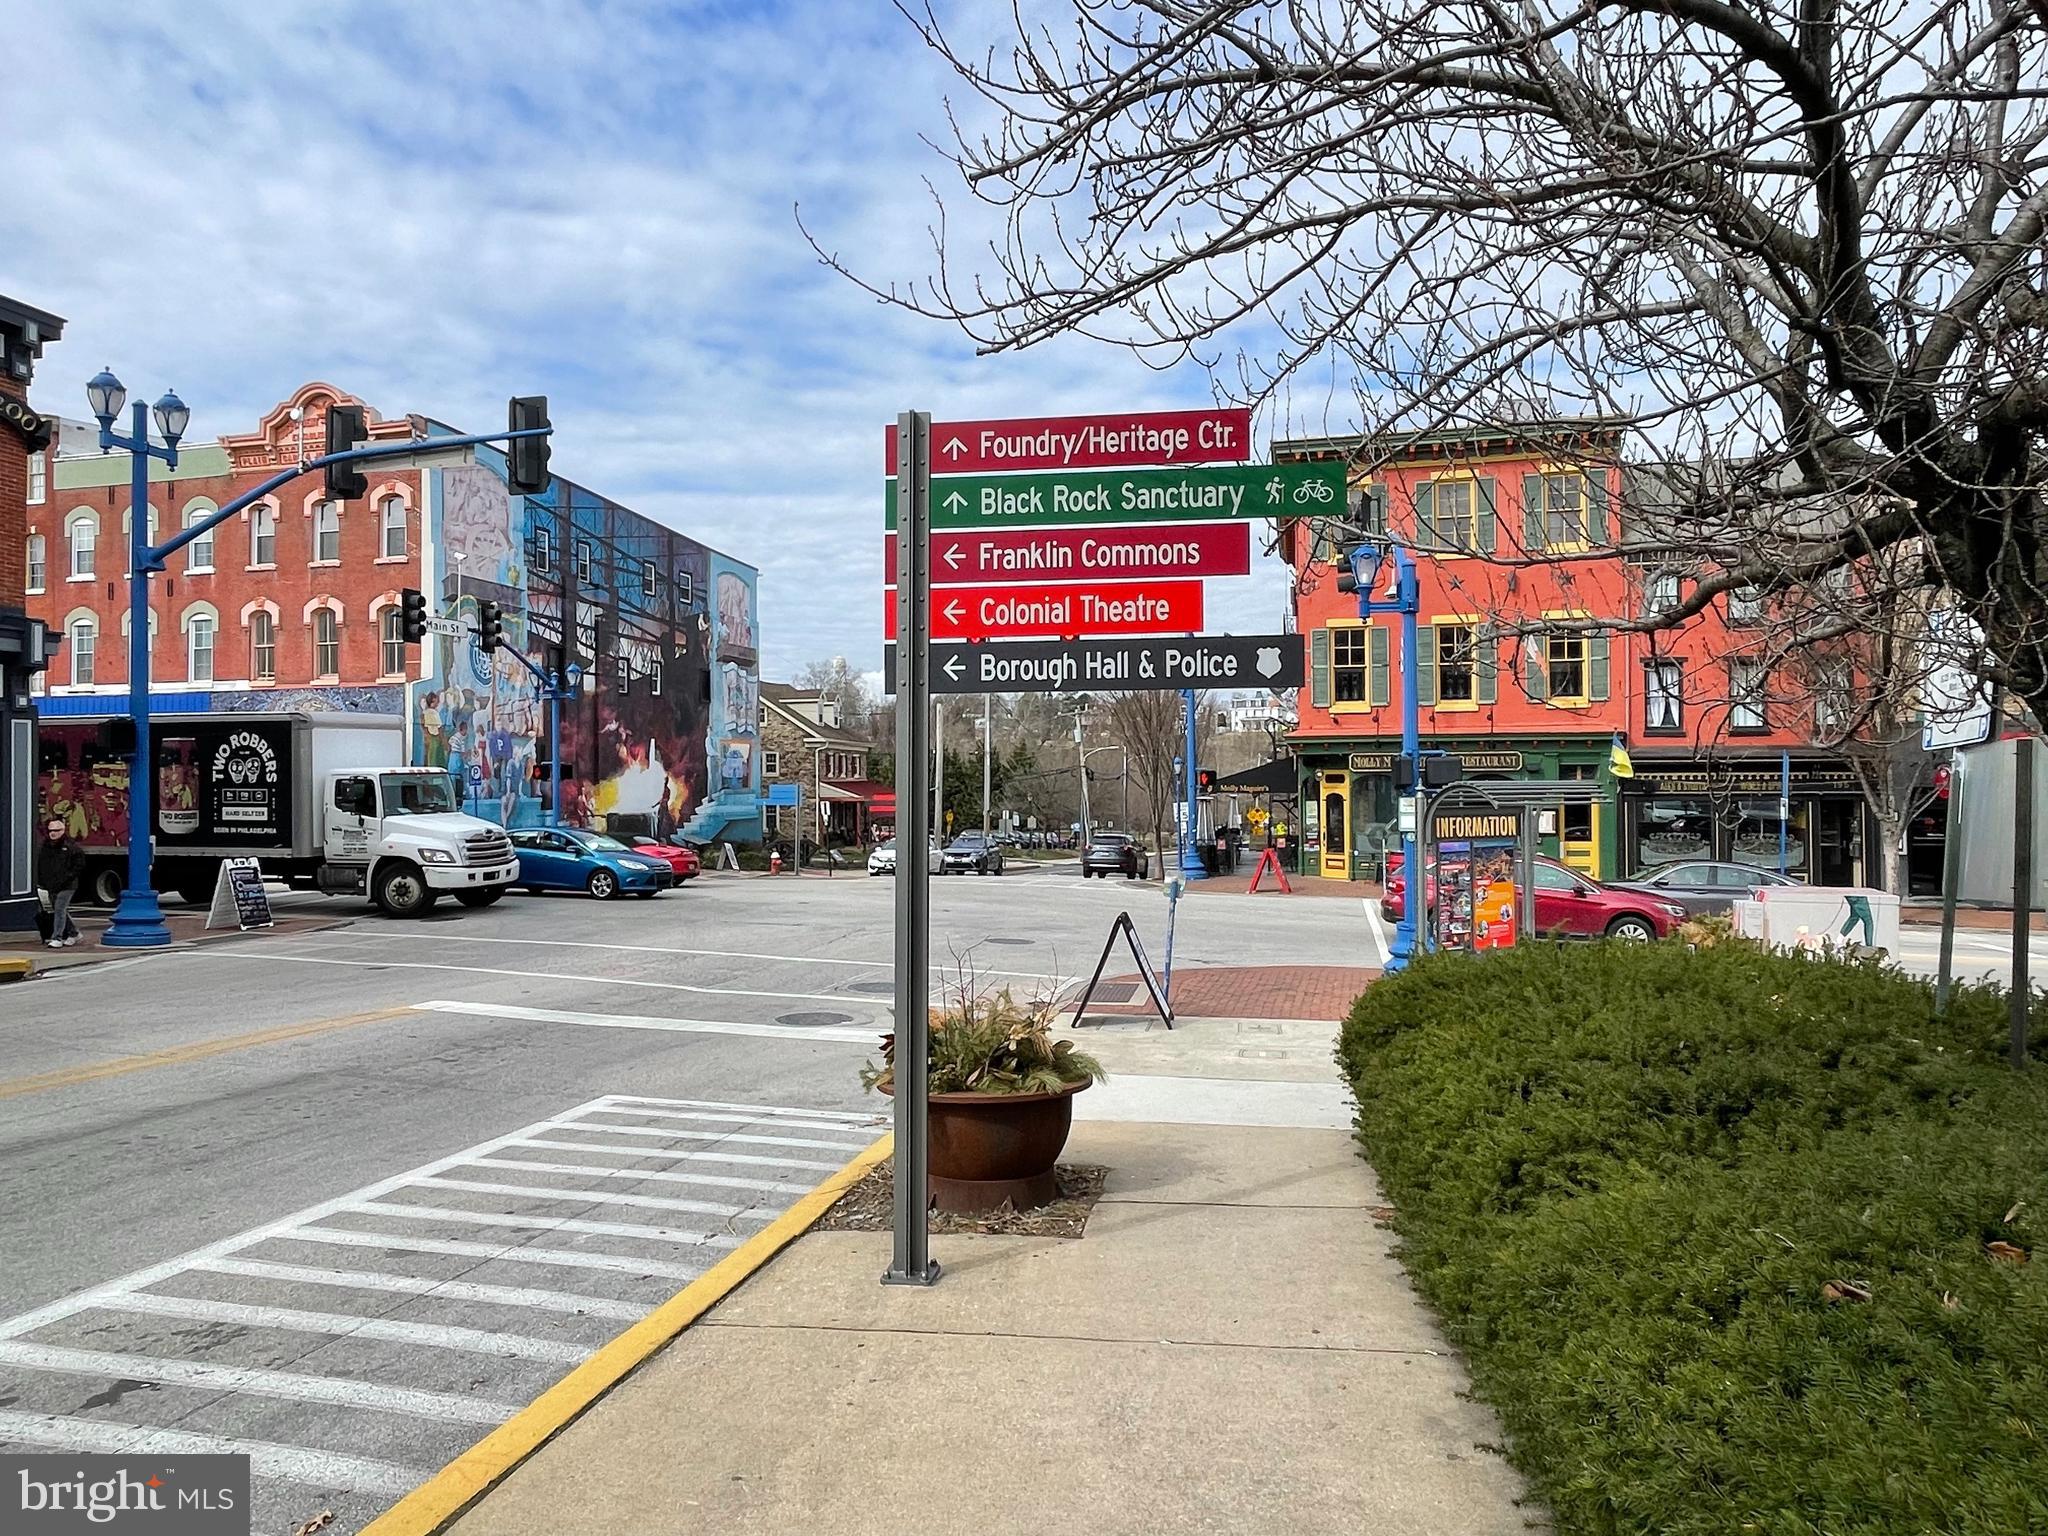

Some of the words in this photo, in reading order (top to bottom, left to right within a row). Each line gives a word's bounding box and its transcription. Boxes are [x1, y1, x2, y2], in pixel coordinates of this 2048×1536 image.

[980, 423, 1190, 465] Foundry/Heritage
[1198, 420, 1238, 449] Ctr.
[981, 486, 1045, 516] Black
[1053, 486, 1112, 513] Rock
[1121, 482, 1245, 516] Sanctuary
[980, 540, 1073, 570] Franklin
[1081, 539, 1200, 568] Commons
[980, 596, 1070, 626] Colonial
[1080, 593, 1170, 623] Theatre
[426, 620, 448, 632] Main
[450, 623, 460, 633] St
[980, 652, 1077, 689] Borough
[1085, 650, 1130, 679] Hall
[1138, 650, 1156, 679] &
[1165, 648, 1239, 678] Police
[212, 743, 231, 782] TWO
[229, 731, 278, 783] ROBBERS
[1353, 756, 1380, 768] MOLLY
[1220, 784, 1239, 792] Molly
[1436, 815, 1517, 839] INFORMATION
